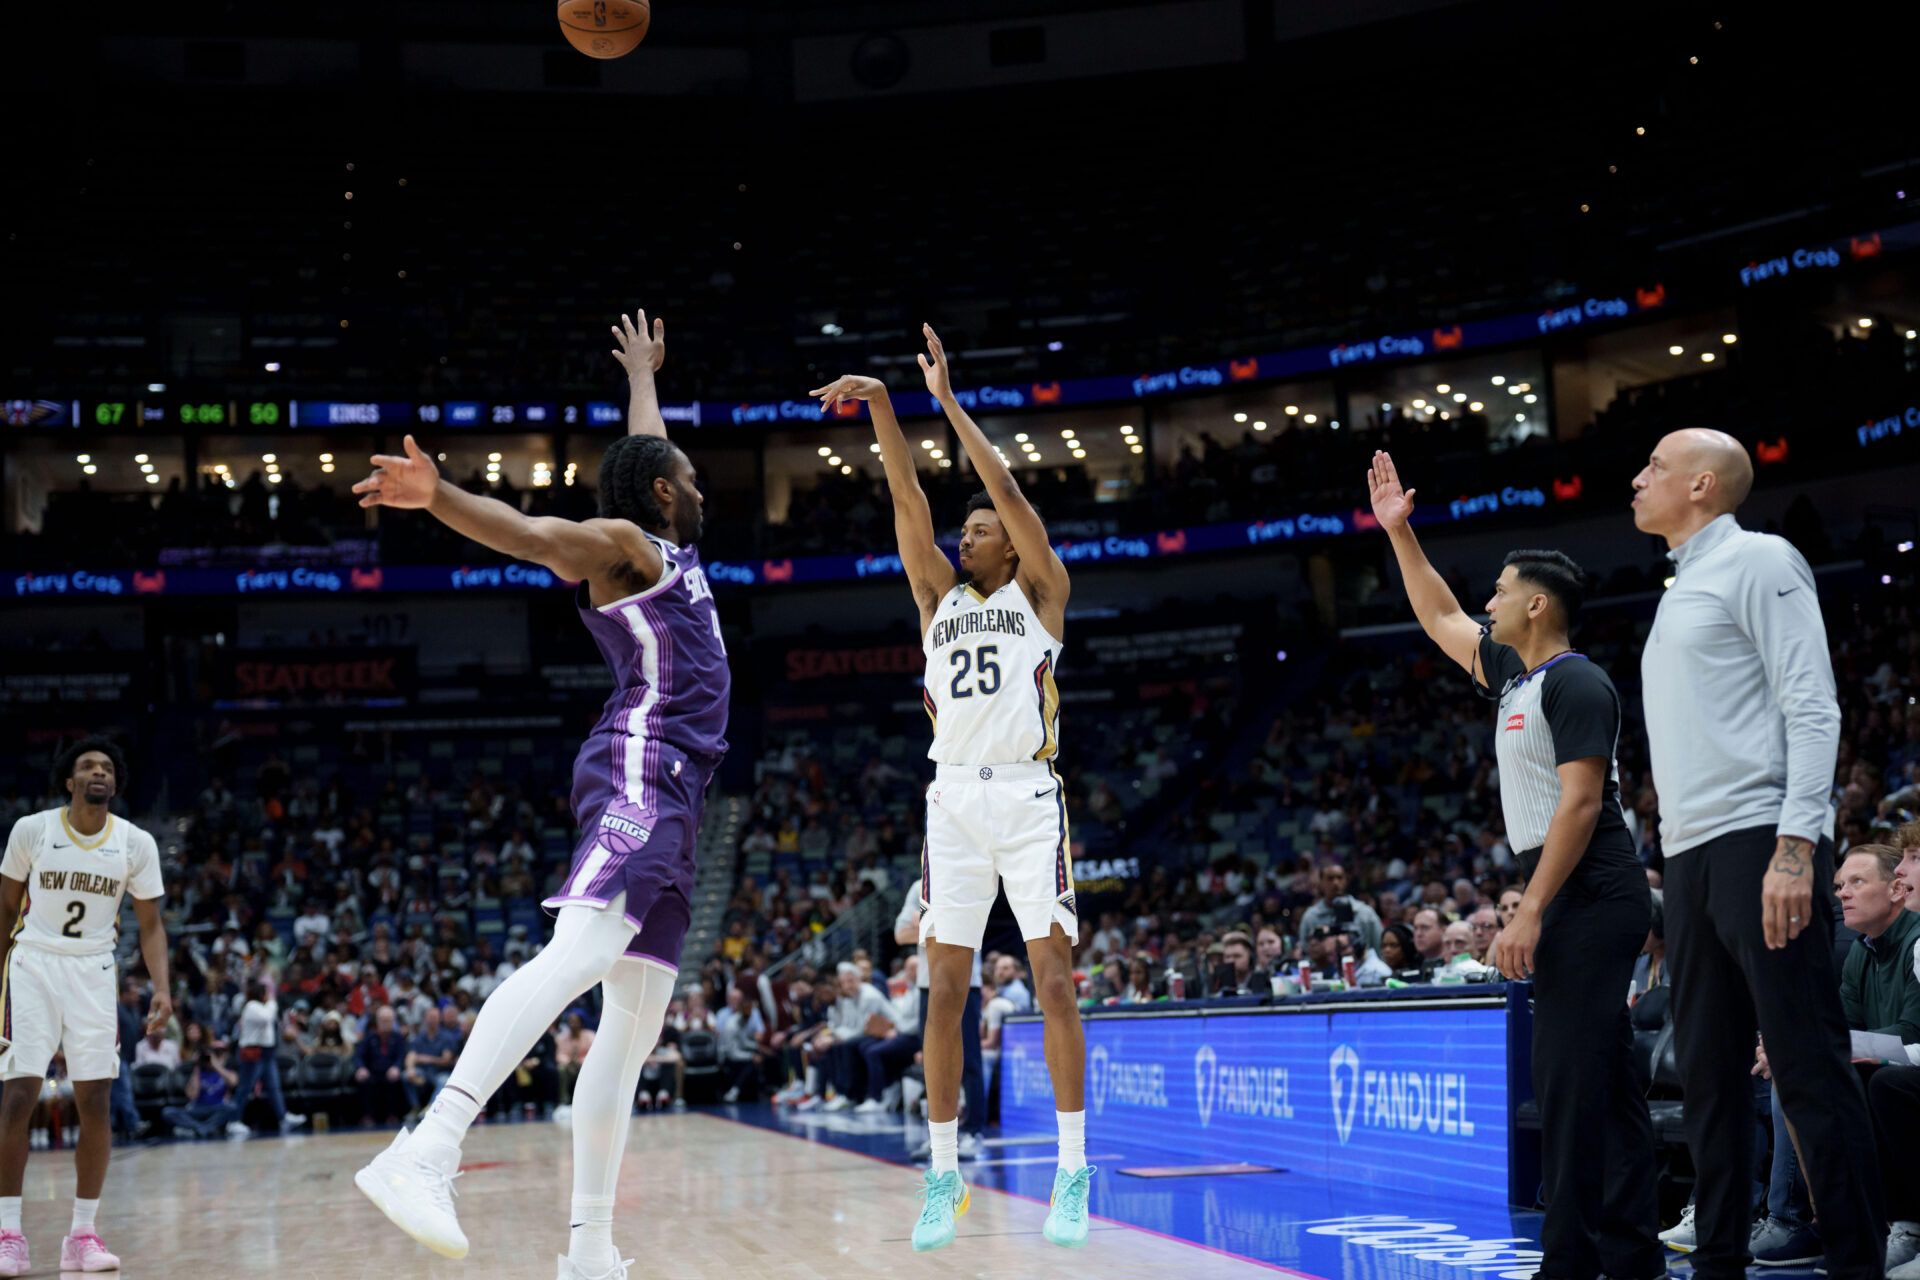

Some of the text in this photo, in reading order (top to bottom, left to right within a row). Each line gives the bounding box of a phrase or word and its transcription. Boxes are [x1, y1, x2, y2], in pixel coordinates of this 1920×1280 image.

[1740, 248, 1840, 286] Fiery Crab
[1538, 298, 1628, 332] Fiery Crab
[1330, 336, 1423, 366] Fiery Crab
[979, 386, 1024, 407] Crab
[1133, 367, 1222, 397] Fiery Crab
[95, 403, 124, 424] 67
[250, 403, 279, 424] 50
[328, 404, 379, 423] KINGS
[732, 400, 824, 424] Fiery Crab
[1858, 417, 1901, 447] Fiery
[1450, 487, 1545, 518] Fiery Crab
[1247, 514, 1344, 544] Fiery Crab
[1104, 536, 1150, 557] Crab
[15, 571, 122, 595] Fiery Crab
[236, 568, 341, 592] Fiery Crab
[452, 564, 552, 588] Fiery Crab
[709, 562, 755, 583] Crab
[932, 609, 1025, 652] NEW ORLEANS
[235, 657, 397, 693] SEATGEEK
[950, 645, 1001, 699] 25
[600, 814, 651, 844] KINGS
[39, 871, 120, 897] NEW ORLEANS
[62, 900, 86, 939] 2
[1218, 1065, 1294, 1120] FANDUEL
[1363, 1070, 1475, 1137] FANDUEL
